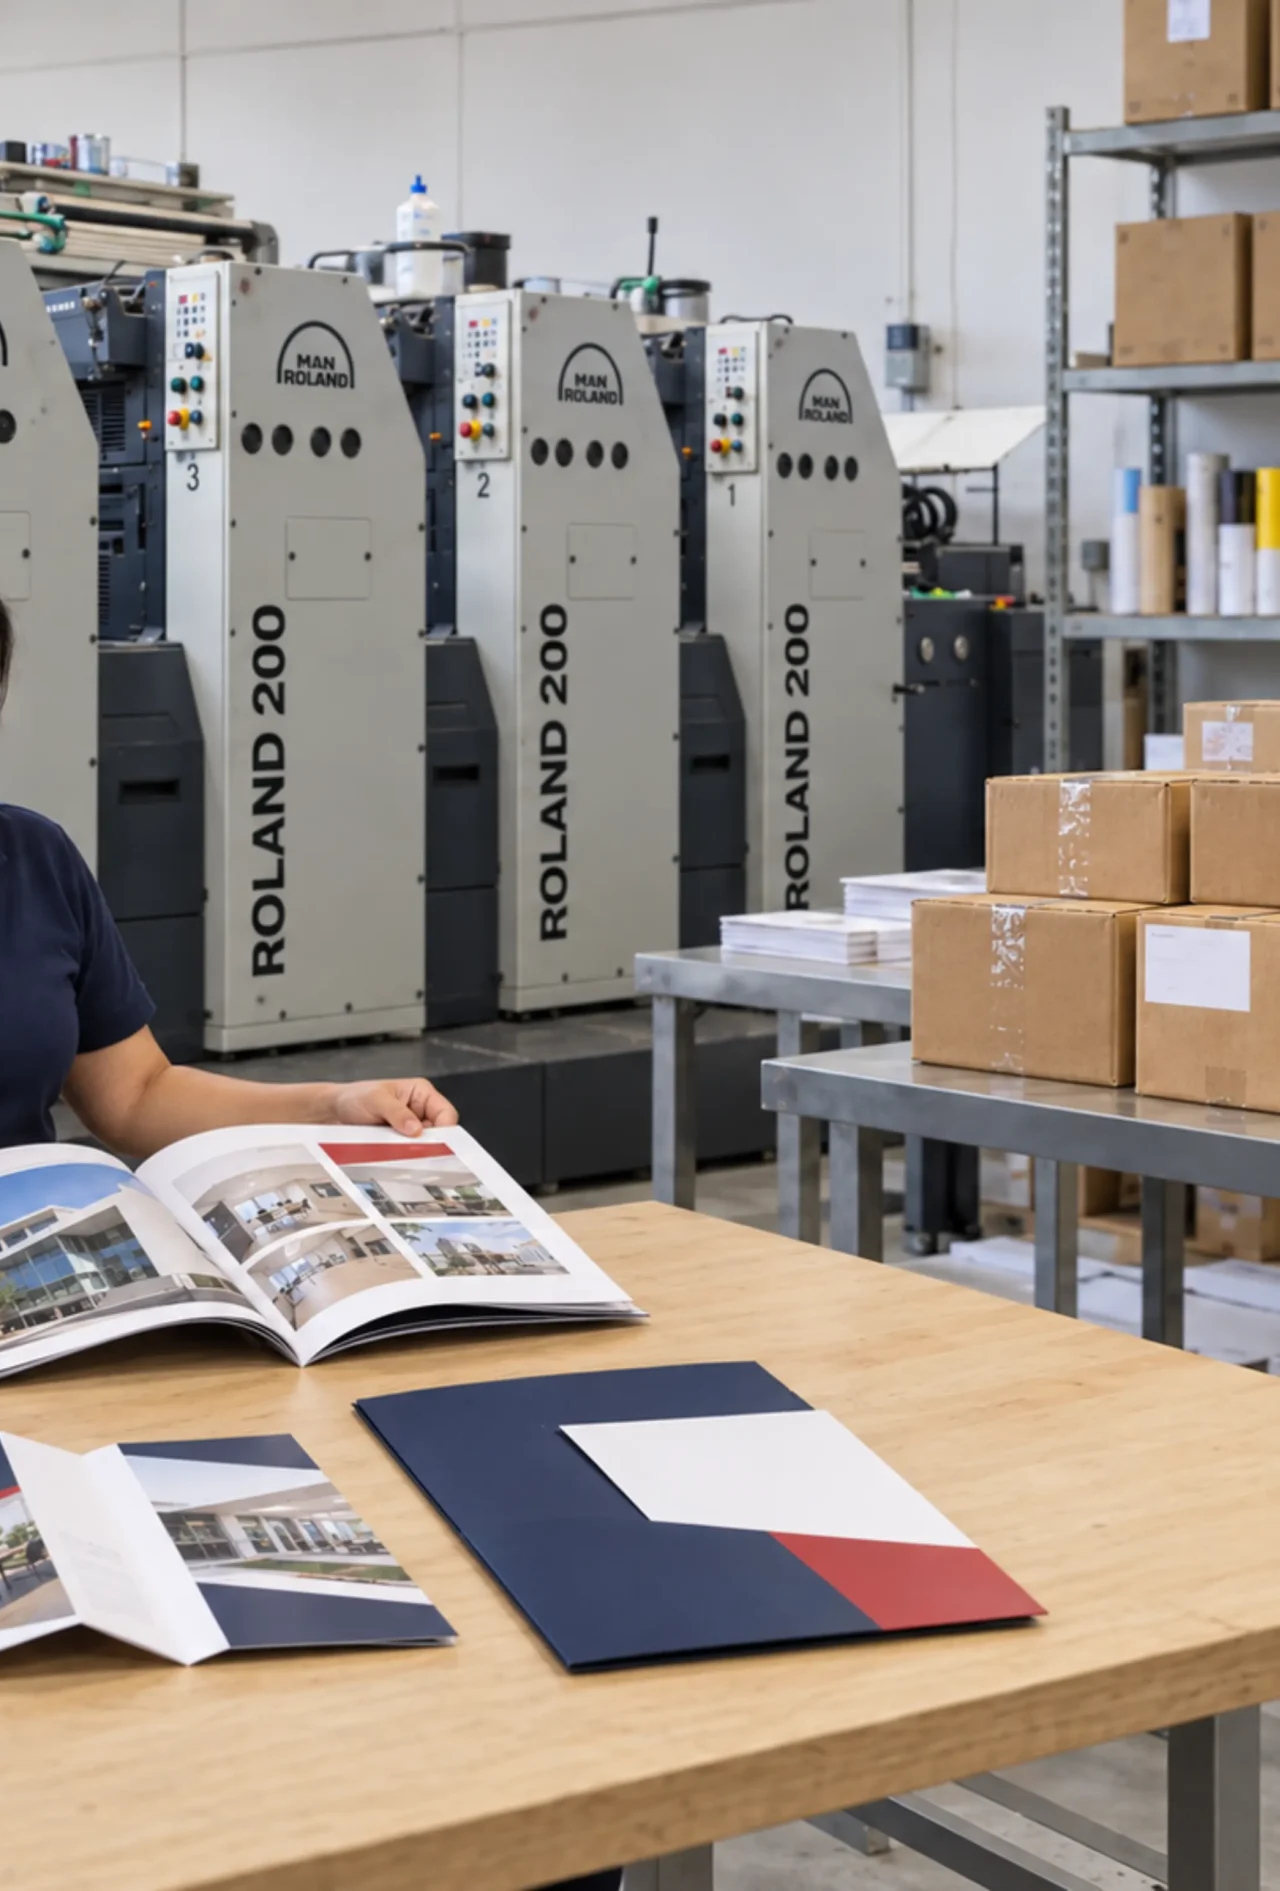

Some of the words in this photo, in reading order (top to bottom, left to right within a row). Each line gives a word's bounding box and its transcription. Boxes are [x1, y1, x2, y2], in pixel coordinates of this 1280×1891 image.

[297, 353, 335, 371] MAN
[284, 369, 349, 389] ROLAND
[574, 372, 608, 389] MAN
[564, 388, 618, 405] ROLAND
[812, 395, 840, 409] MAN
[186, 463, 200, 492] 3
[477, 472, 490, 499] 2
[727, 483, 736, 507] 1
[251, 604, 286, 716] 200
[539, 603, 569, 706] 200
[784, 603, 811, 697] 200
[784, 710, 811, 911] ROLAND
[539, 719, 569, 942] ROLAND
[251, 732, 286, 978] ROLAND
